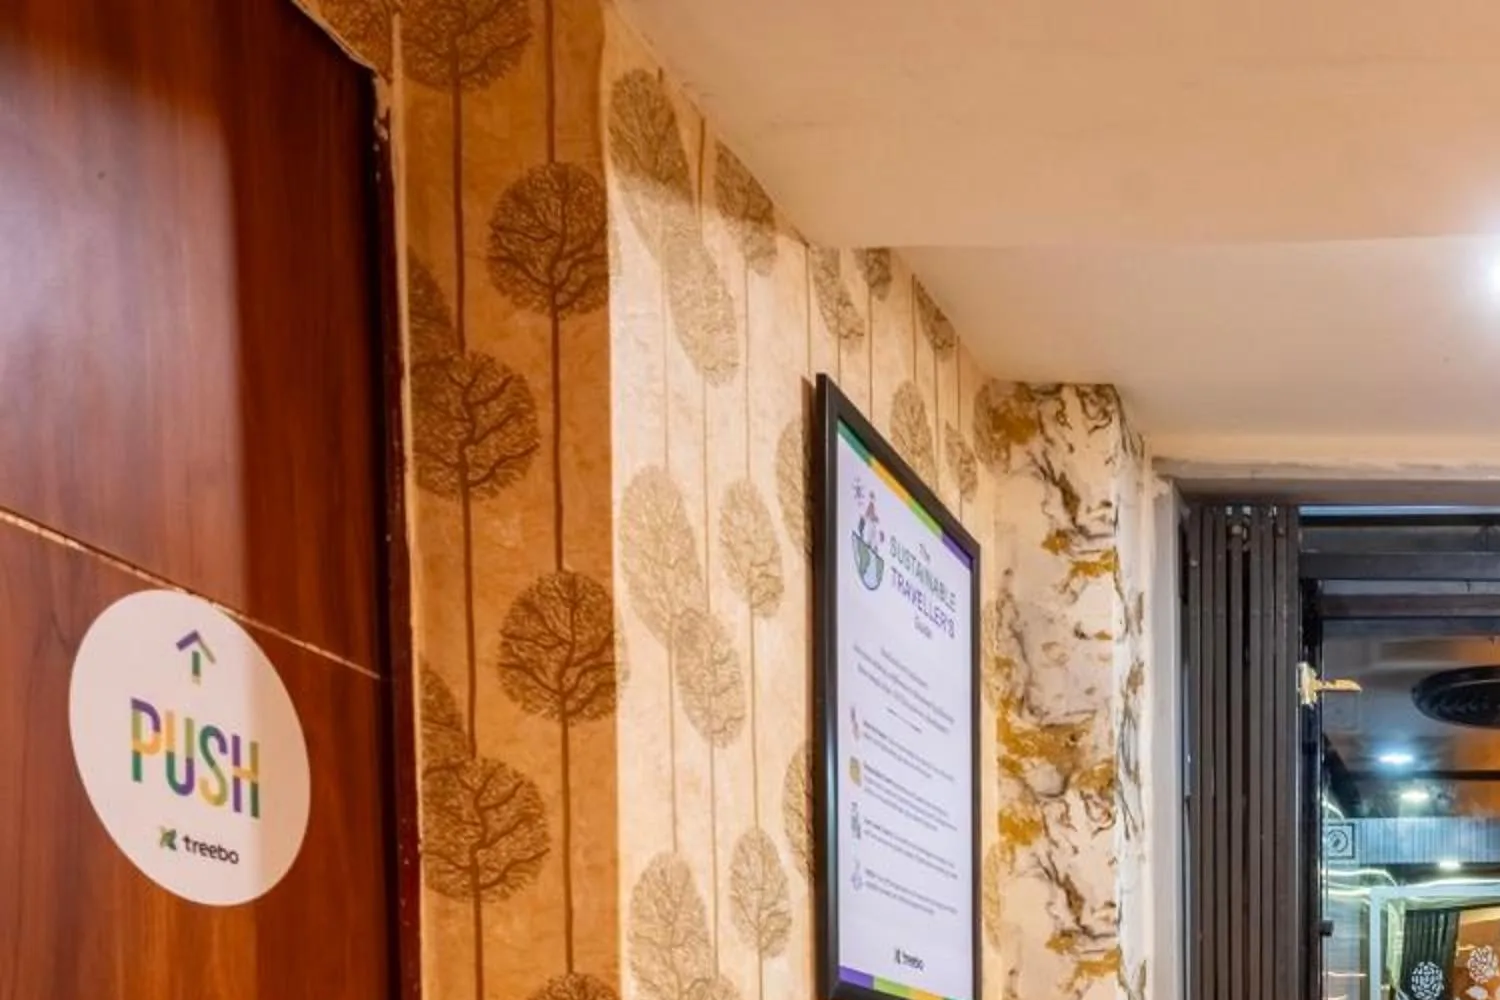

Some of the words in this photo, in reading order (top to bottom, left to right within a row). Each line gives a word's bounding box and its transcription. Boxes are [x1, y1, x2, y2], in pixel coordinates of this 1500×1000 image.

[889, 535, 957, 614] SUSTAINABLE
[130, 698, 261, 820] PUSH
[182, 833, 240, 865] treebo
